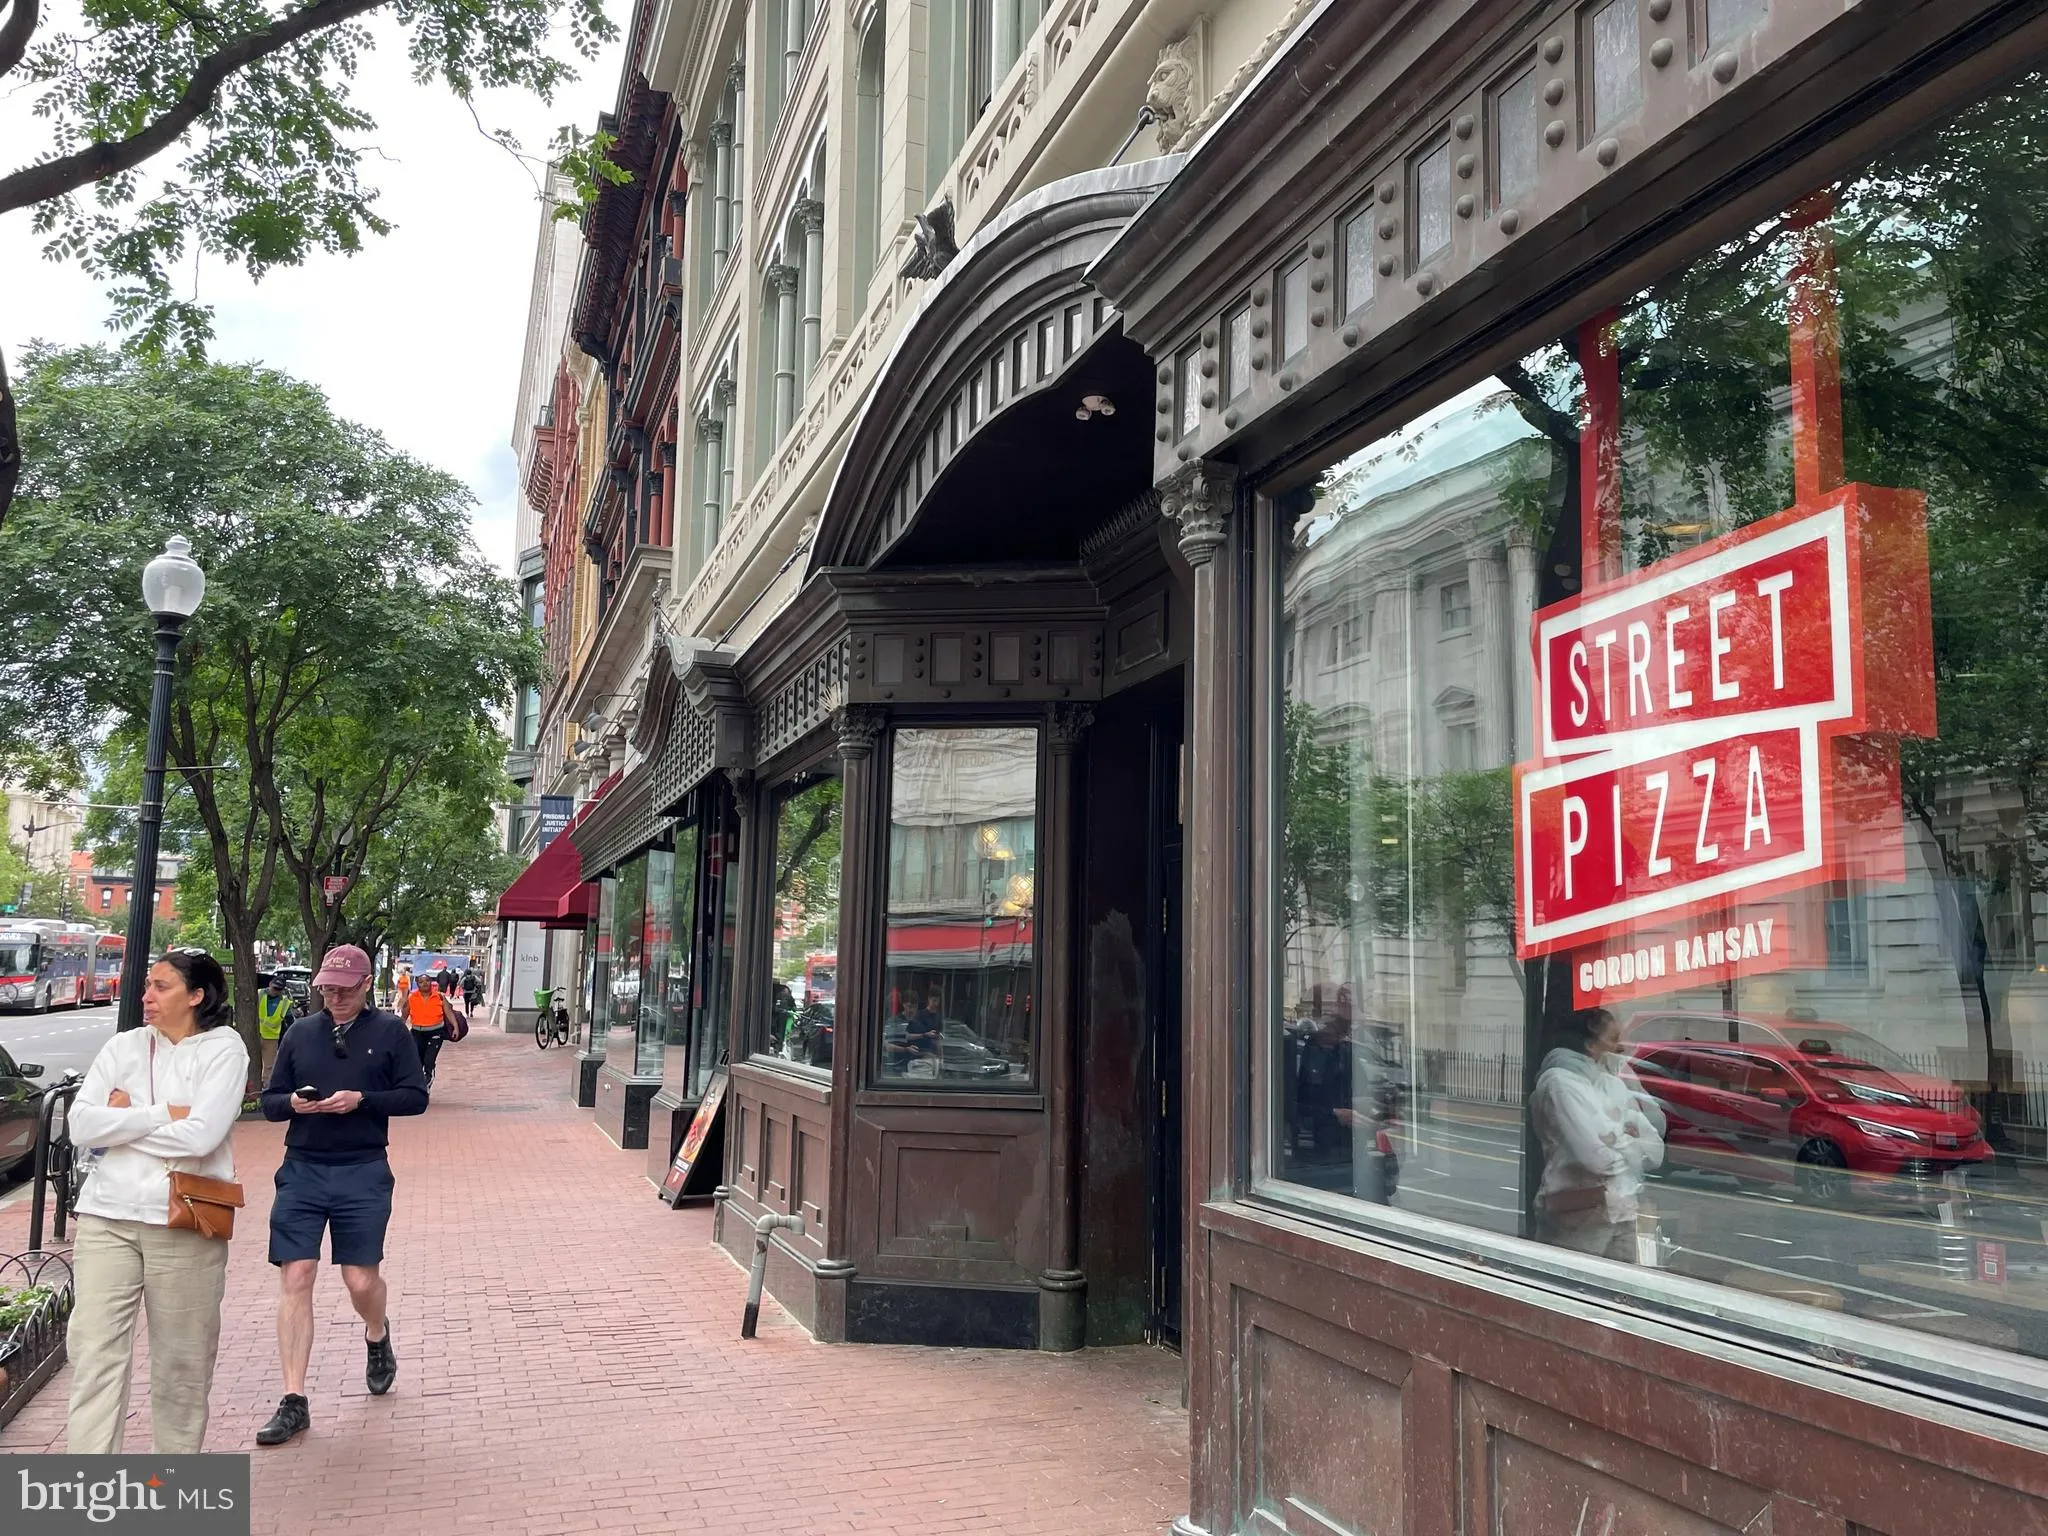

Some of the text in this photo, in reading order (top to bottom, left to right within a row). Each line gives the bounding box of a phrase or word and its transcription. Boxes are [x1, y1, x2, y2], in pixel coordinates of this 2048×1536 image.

[1569, 570, 1794, 728] STREET
[1562, 745, 1772, 900] PIZZA
[1579, 918, 1774, 993] GORDON RAMSAY
